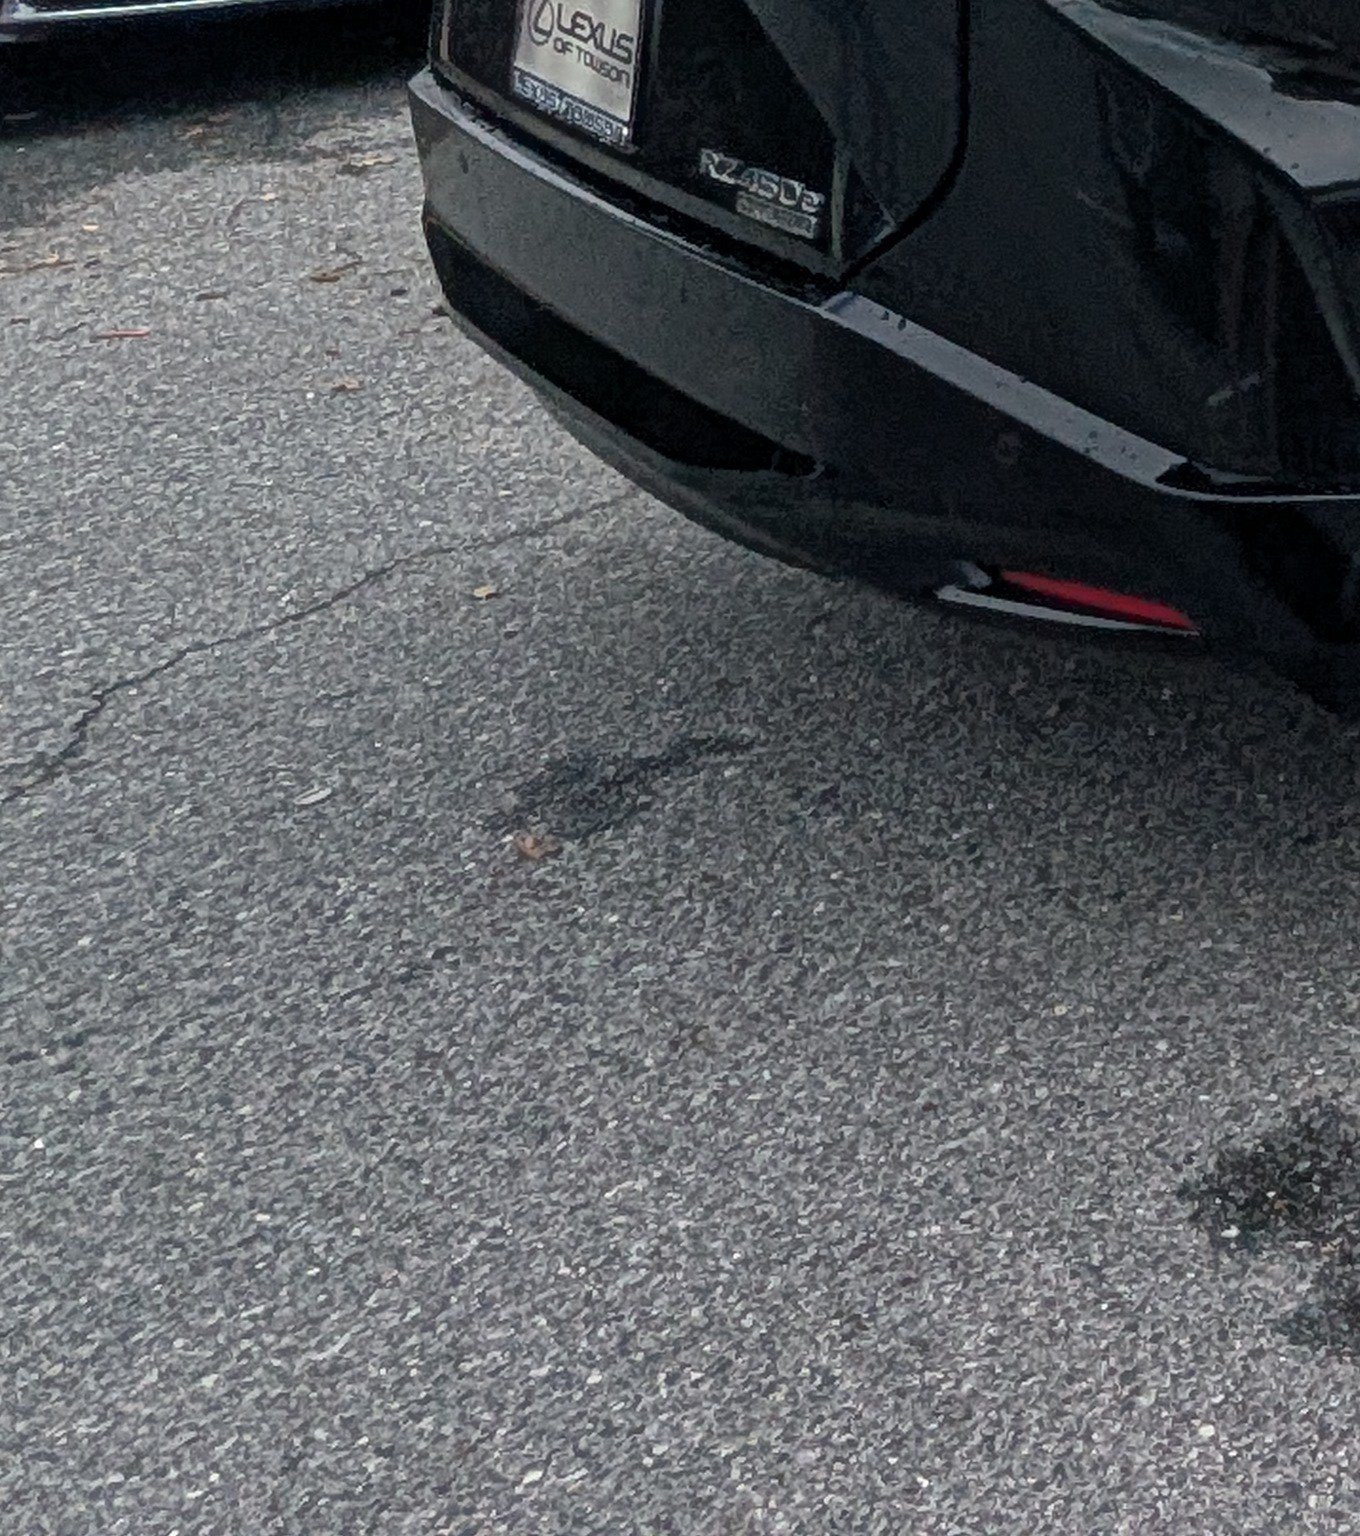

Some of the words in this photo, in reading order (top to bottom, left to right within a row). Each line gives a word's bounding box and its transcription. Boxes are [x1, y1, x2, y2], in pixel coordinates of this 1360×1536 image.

[552, 37, 576, 60] OF
[576, 47, 631, 89] TOWSON
[556, 2, 634, 66] LEXUS
